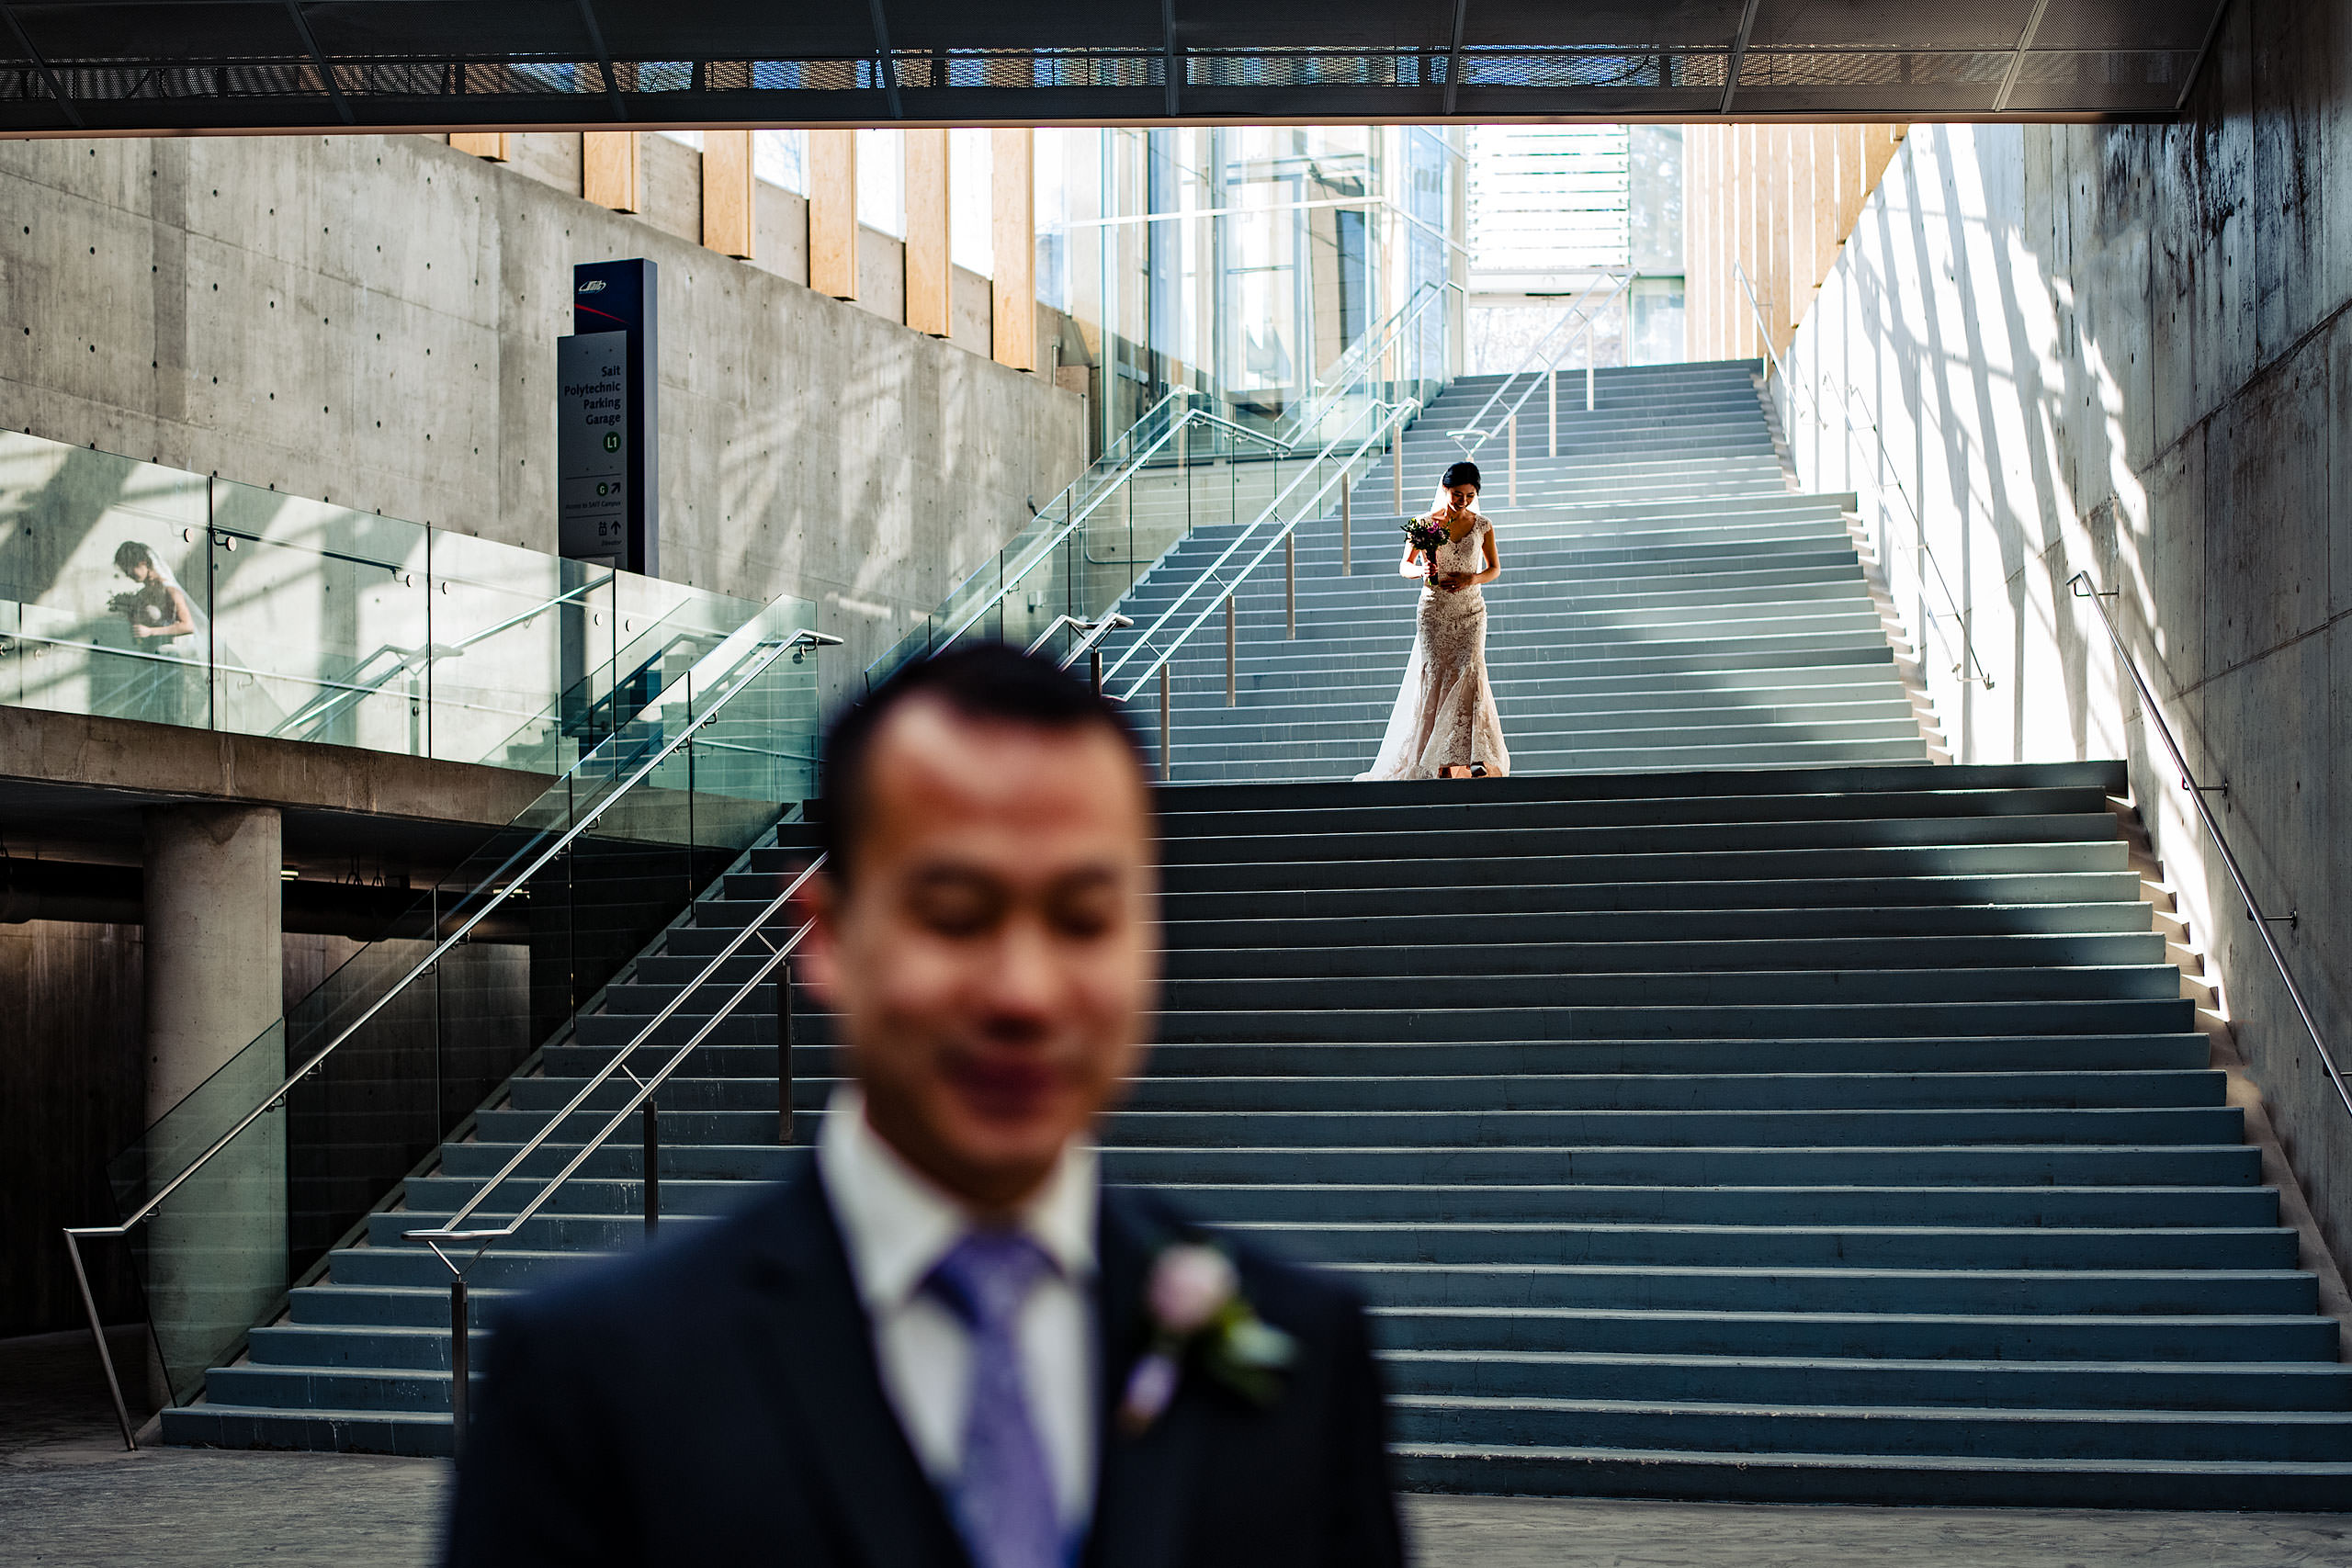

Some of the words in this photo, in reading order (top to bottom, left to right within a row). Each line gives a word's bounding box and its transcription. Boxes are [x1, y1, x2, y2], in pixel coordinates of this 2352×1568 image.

[602, 365, 621, 377] Sait
[564, 382, 621, 397] Polytechnic
[583, 397, 621, 411] Parking
[585, 413, 621, 426] Garage
[607, 436, 617, 448] L1
